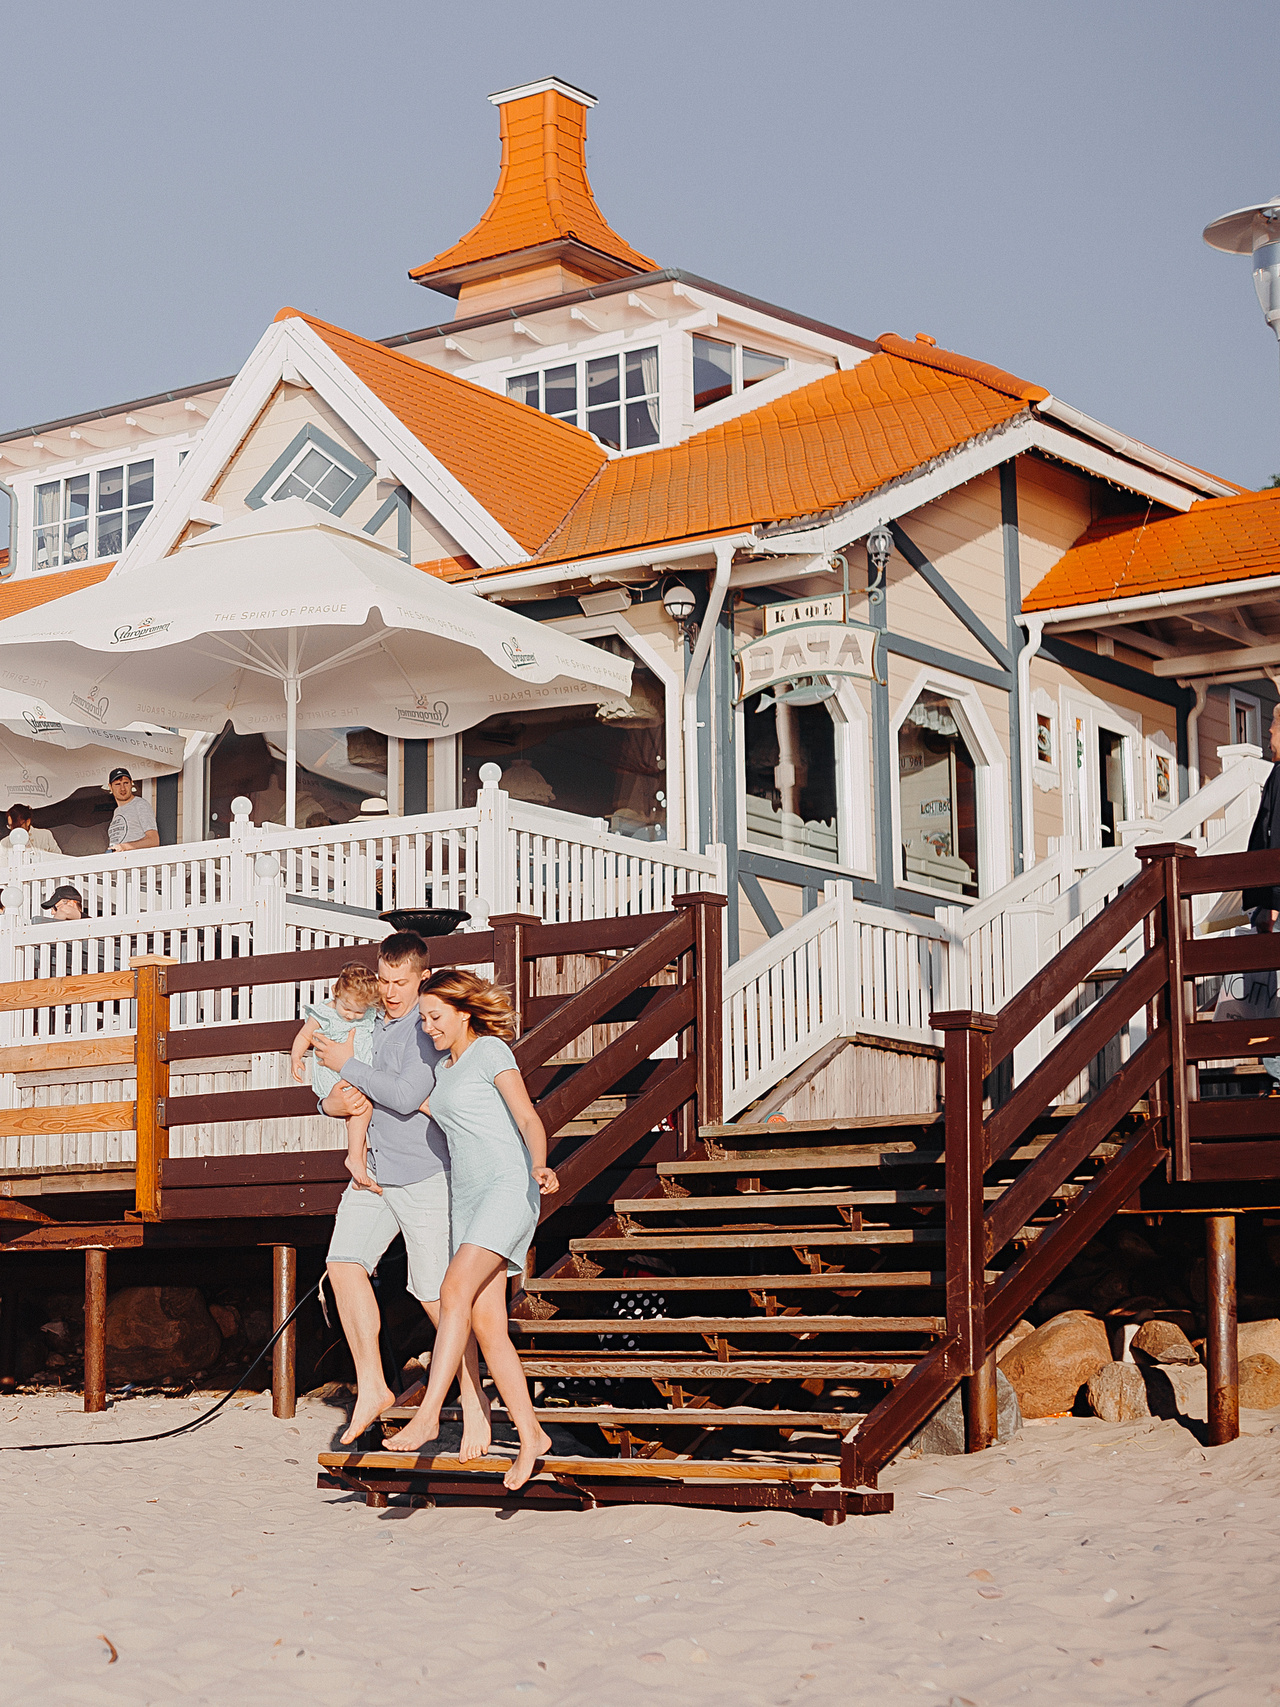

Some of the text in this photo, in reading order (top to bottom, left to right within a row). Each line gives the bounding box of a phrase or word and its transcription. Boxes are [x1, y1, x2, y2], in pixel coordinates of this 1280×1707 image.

[214, 603, 347, 622] THE SPIRIT OF PRAGUE
[774, 602, 833, 624] КАФЕ
[110, 620, 173, 644] Staropramen
[86, 726, 174, 755] THE SPIRIT OF PRAGUE
